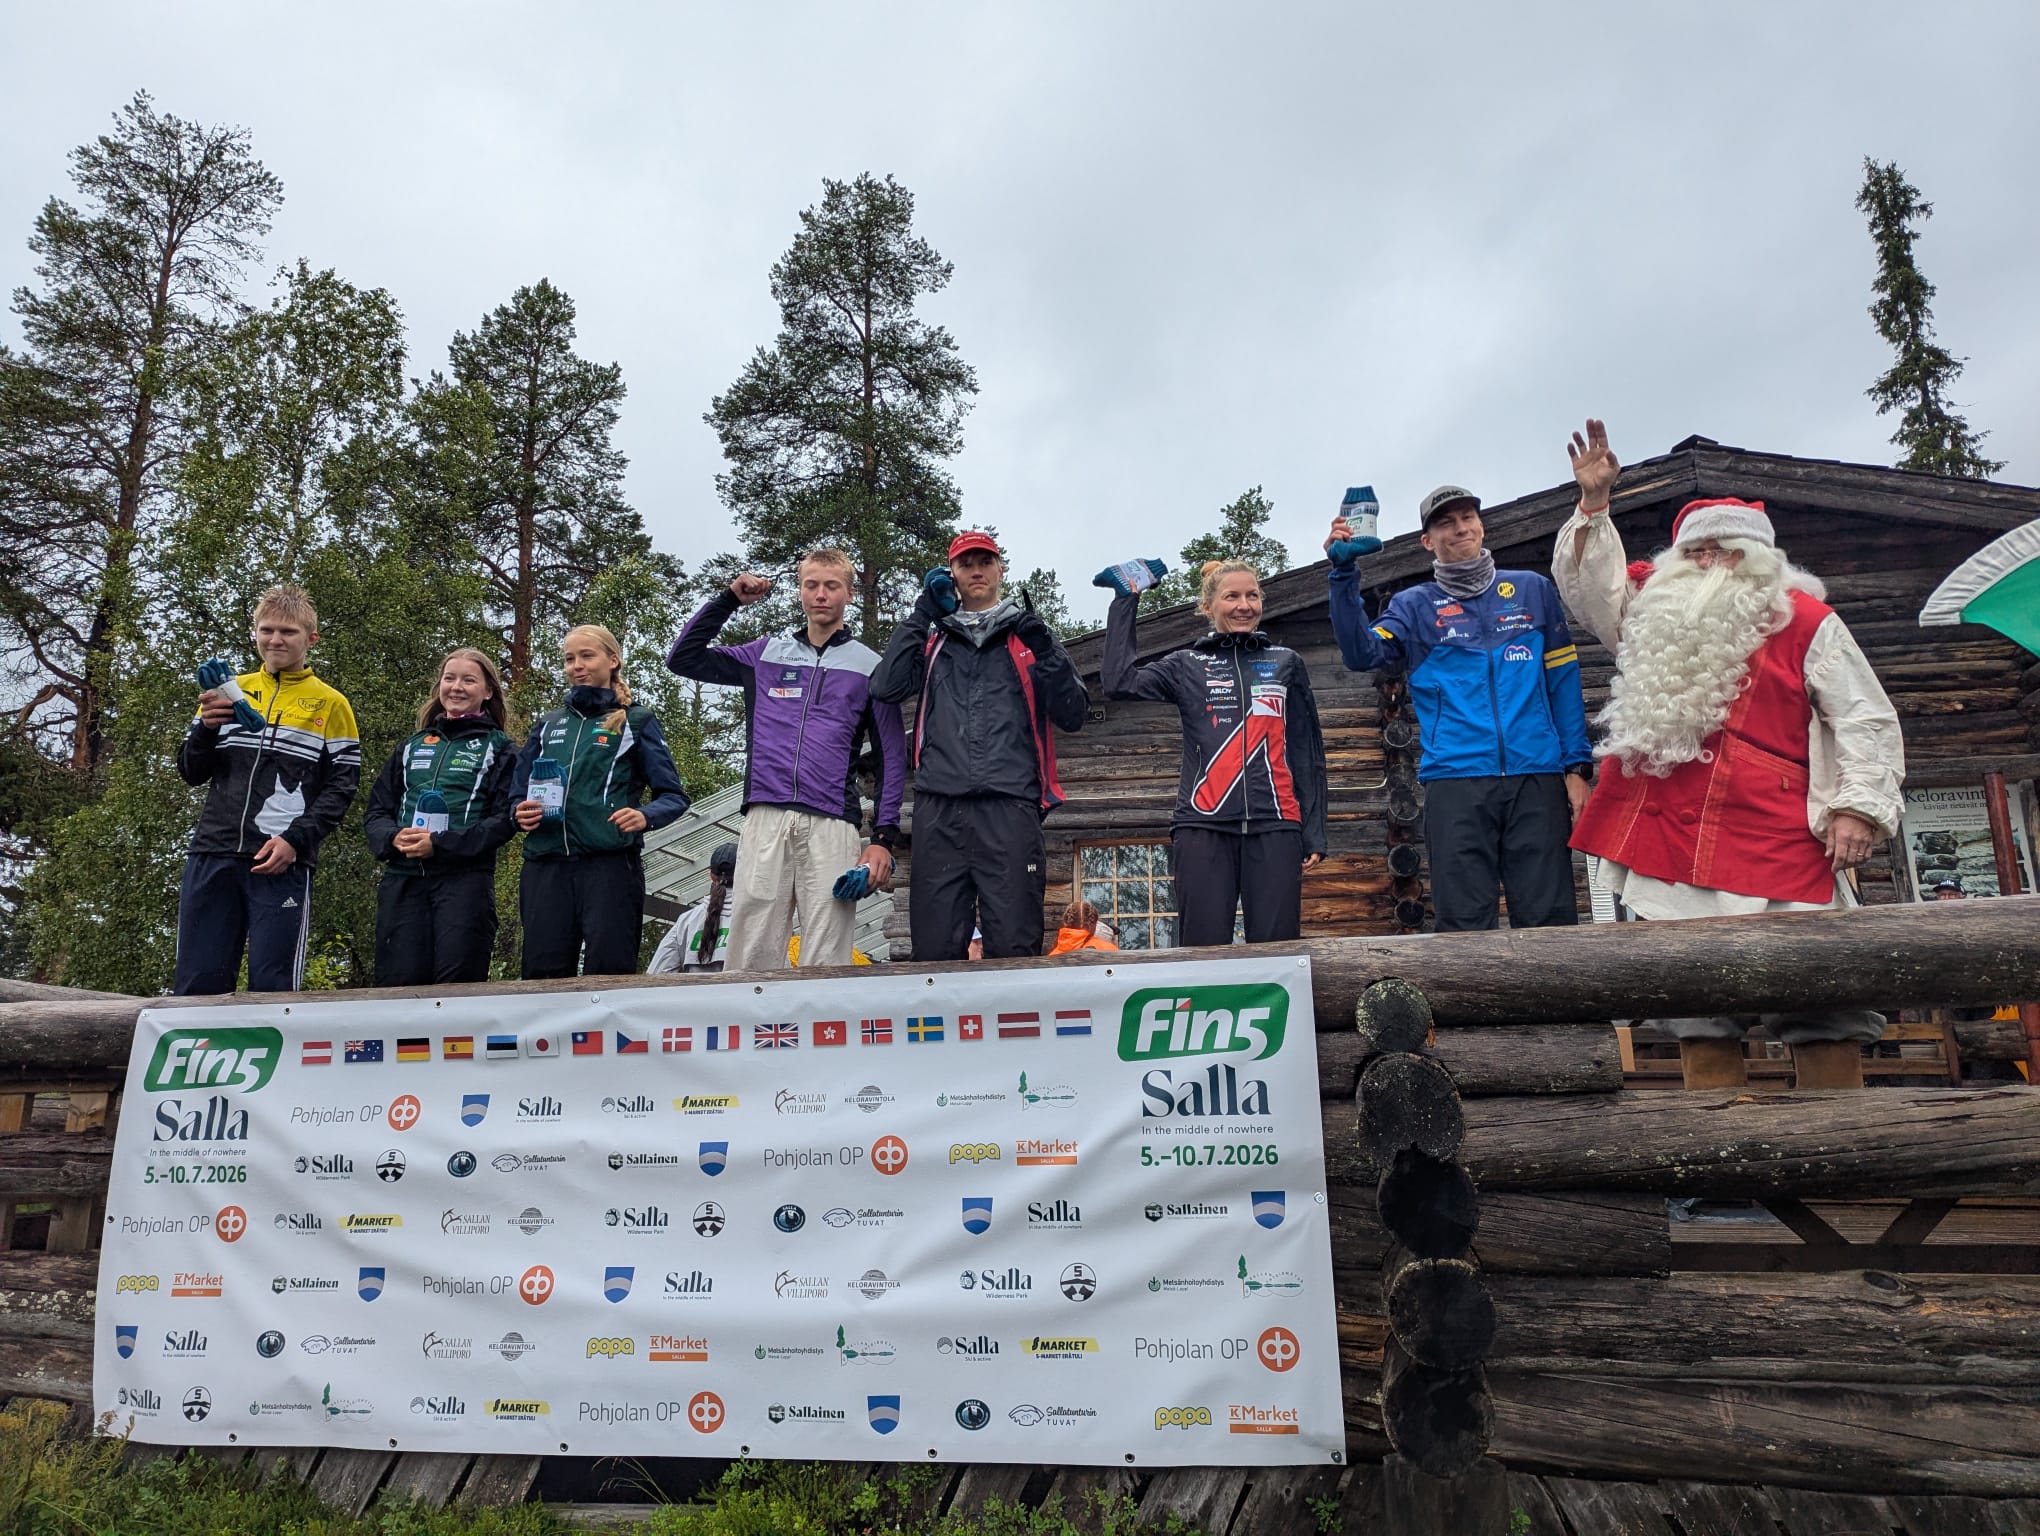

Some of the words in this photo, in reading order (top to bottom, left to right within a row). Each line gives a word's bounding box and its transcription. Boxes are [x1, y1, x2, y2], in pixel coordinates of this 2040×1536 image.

[1135, 998, 1271, 1061] Fin5
[157, 1038, 269, 1093] Fin5
[795, 1094, 827, 1103] SALLAN
[1141, 1064, 1272, 1117] Salla
[517, 1096, 562, 1116] Salla
[616, 1096, 654, 1113] Salla
[786, 1105, 826, 1114] VILLIPORO
[153, 1095, 249, 1142] Salla
[291, 1107, 354, 1128] Pohjolan
[360, 1105, 382, 1122] OP
[1141, 1126, 1152, 1135] In
[1155, 1126, 1171, 1135] the
[1175, 1125, 1210, 1135] middle
[1214, 1125, 1224, 1134] of
[1228, 1125, 1274, 1134] nowhere
[159, 1149, 171, 1157] the
[172, 1148, 200, 1157] middle
[201, 1148, 211, 1157] of
[213, 1148, 246, 1156] nowhere
[1028, 1140, 1078, 1153] Market
[311, 1153, 354, 1174] Salla
[626, 1153, 678, 1164] Sallainen
[764, 1148, 833, 1170] Pohjolan
[839, 1147, 864, 1165] OP
[623, 1206, 668, 1227] Salla
[1028, 1200, 1081, 1222] Salla
[1167, 1203, 1228, 1216] Sallainen
[122, 1216, 183, 1237] Pohjolan
[189, 1215, 210, 1233] OP
[289, 1213, 322, 1229] Salla
[463, 1214, 490, 1224] SALLAN
[452, 1225, 490, 1234] VILLIPORO
[184, 1273, 223, 1286] Market
[289, 1277, 338, 1289] Sallainen
[423, 1276, 484, 1297] Pohjolan
[490, 1275, 513, 1295] OP
[664, 1271, 713, 1293] Salla
[797, 1277, 829, 1287] SALLAN
[848, 1281, 901, 1289] KELORAVINTOLA
[981, 1267, 1032, 1290] Salla
[786, 1288, 829, 1298] VILLIPORO
[164, 1330, 207, 1351] Salla
[443, 1337, 473, 1348] SALLAN
[488, 1343, 536, 1351] KELORAVINTOLA
[661, 1335, 708, 1349] Market
[955, 1335, 999, 1354] Salla
[1040, 1341, 1087, 1351] MARKET
[433, 1349, 471, 1359] VILLIPORO
[1135, 1338, 1213, 1363] Pohjolan
[1220, 1339, 1249, 1359] OP
[129, 1388, 161, 1410] Salla
[426, 1396, 465, 1414] Salla
[579, 1402, 649, 1425] Pohjolan
[656, 1401, 681, 1421] OP
[788, 1405, 845, 1419] Sallainen
[1242, 1405, 1298, 1422] Market
